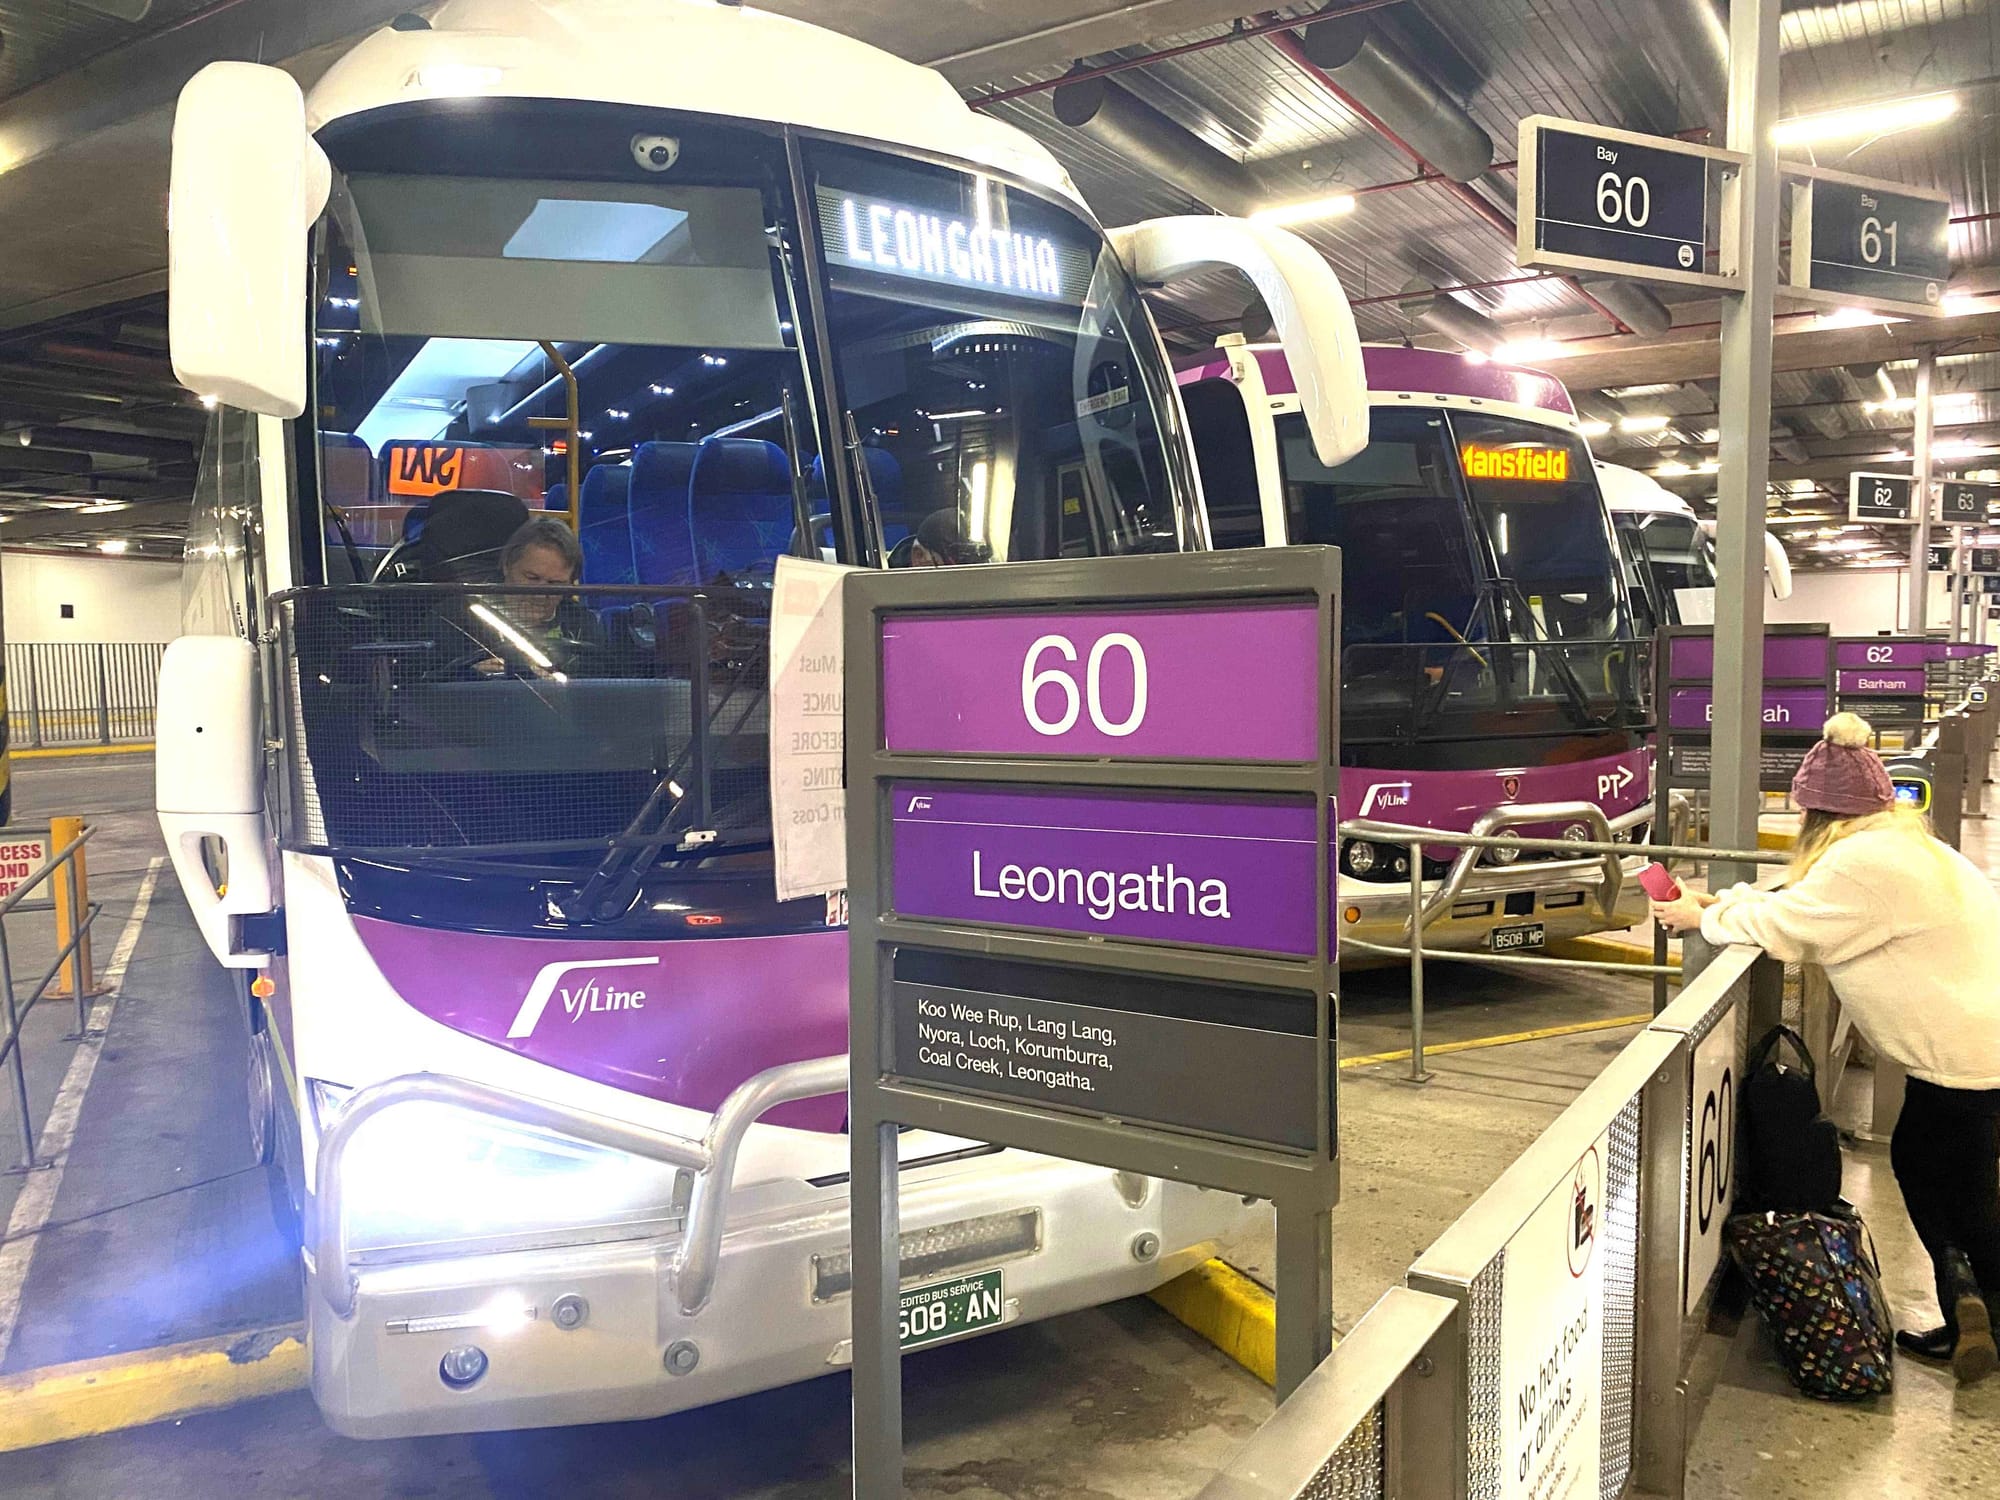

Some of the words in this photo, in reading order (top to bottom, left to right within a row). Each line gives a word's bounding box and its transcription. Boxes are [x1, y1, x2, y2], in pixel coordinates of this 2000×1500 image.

[1597, 146, 1618, 165] Bay
[1596, 172, 1650, 228] 60
[1861, 194, 1878, 210] Bay
[844, 198, 1061, 296] LEONGATHA
[1860, 216, 1898, 267] 61
[1874, 488, 1892, 506] 62
[1958, 493, 1975, 510] 63
[1867, 646, 1893, 663] 62
[1021, 632, 1148, 737] 60
[1858, 678, 1906, 689] Barham
[973, 850, 1231, 920] Leongatha
[1529, 930, 1543, 944] MP
[559, 977, 646, 1024] V/Line
[918, 999, 947, 1018] Koo
[950, 1003, 983, 1023] Wee
[988, 1009, 1023, 1032] Rup,
[1027, 1014, 1066, 1037] Lang
[1072, 1021, 1117, 1046] Lang,
[918, 1023, 964, 1047] Nyora,
[969, 1030, 1010, 1054] Loch,
[1015, 1037, 1113, 1071] Korumburra,
[918, 1047, 951, 1067] Coal
[955, 1053, 1003, 1078] Creek,
[1008, 1061, 1095, 1092] Leongatha.
[1698, 1066, 1731, 1236] 60
[900, 1292, 931, 1308] EDITED
[932, 1289, 949, 1301] BUS
[950, 1280, 984, 1297] SERVICE
[965, 1287, 1000, 1323] AN
[1519, 1384, 1536, 1432] No
[1539, 1344, 1559, 1400] hot
[1563, 1296, 1588, 1363] food
[1519, 1439, 1533, 1483] or
[1536, 1377, 1572, 1454] drinks
